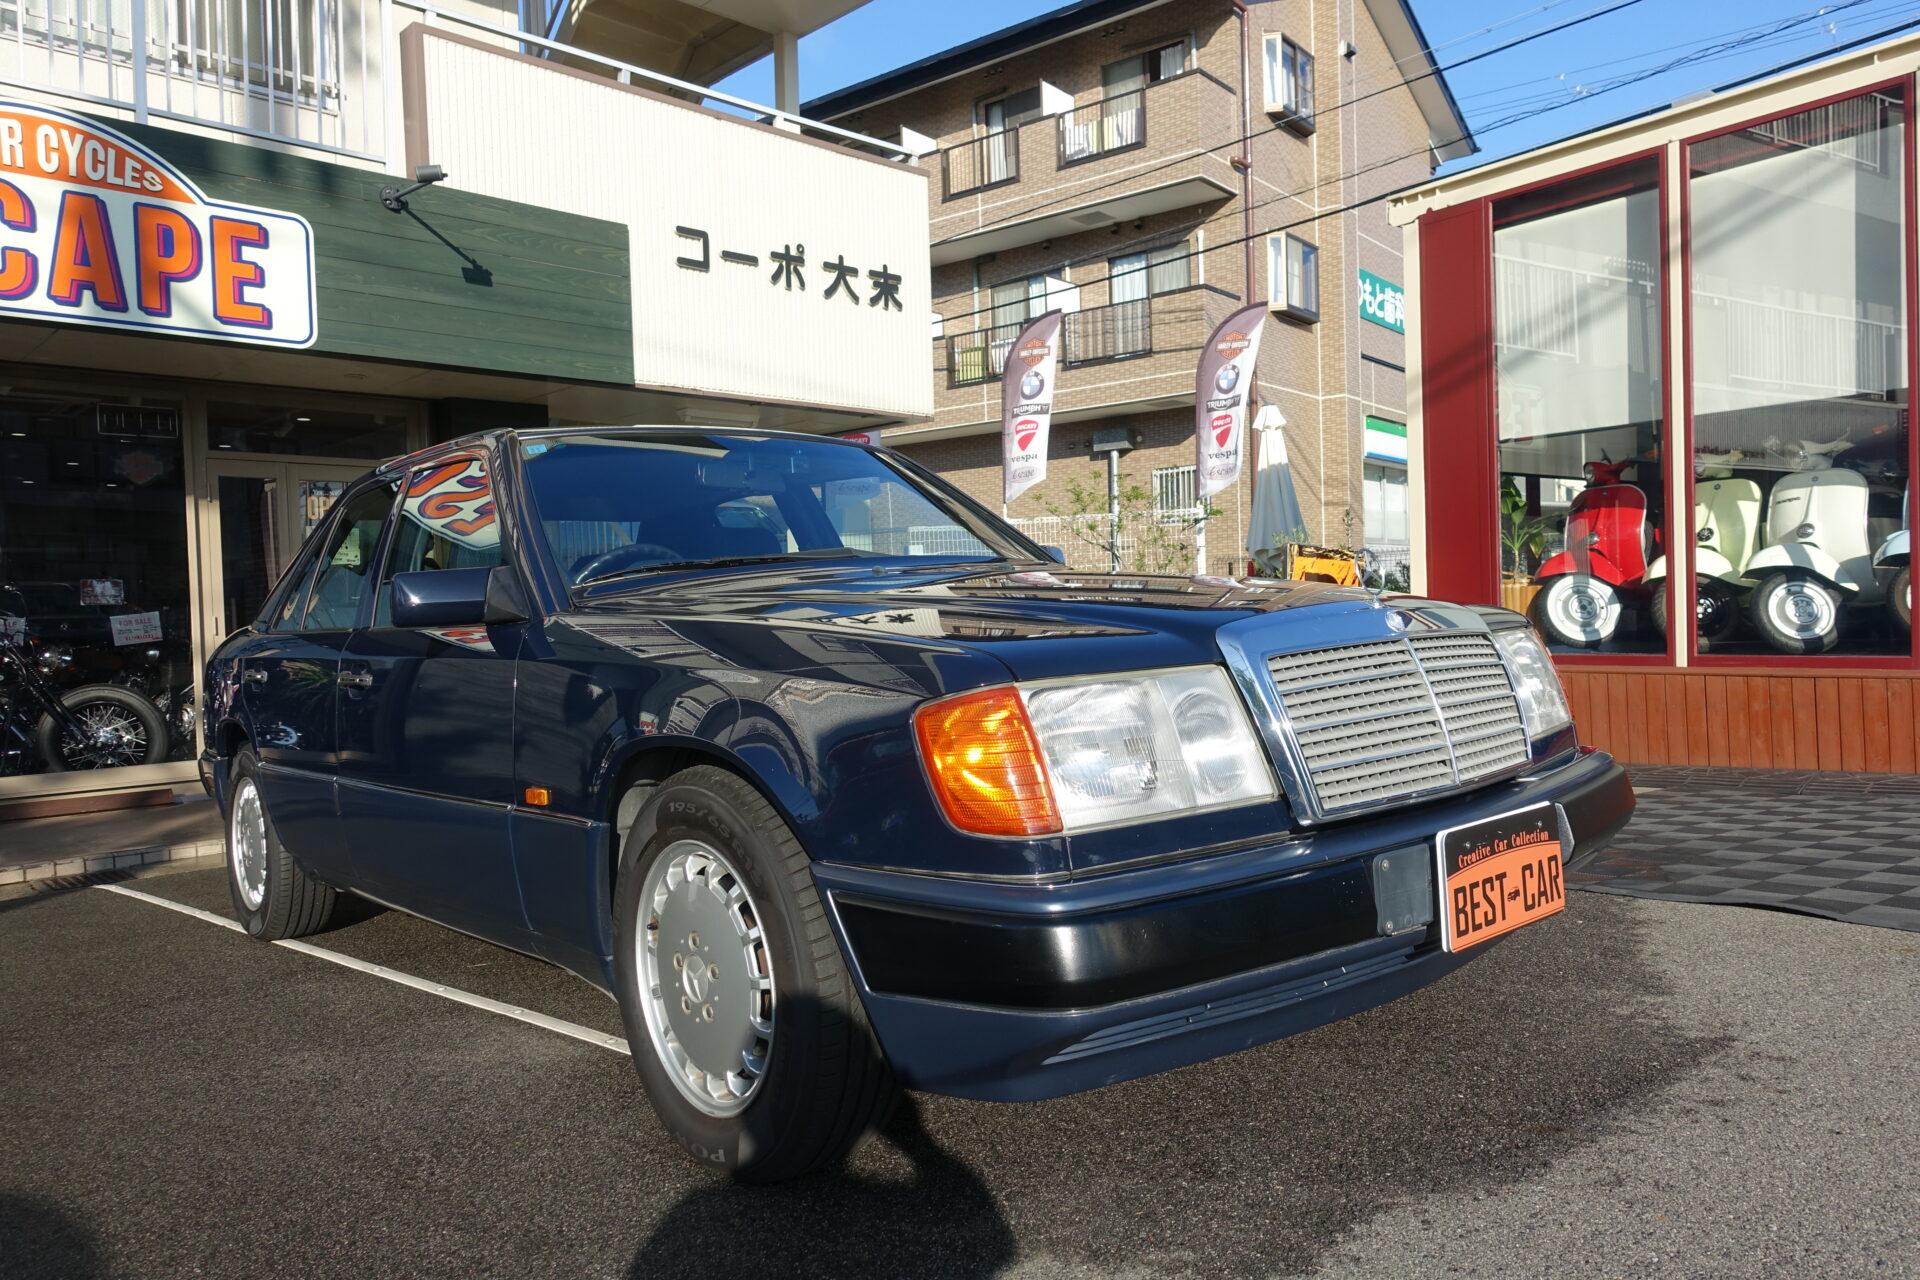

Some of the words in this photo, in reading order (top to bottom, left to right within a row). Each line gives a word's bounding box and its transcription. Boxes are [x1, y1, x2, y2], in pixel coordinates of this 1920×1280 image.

[36, 124, 163, 192] CYCLES
[675, 225, 903, 311] コーポ大末
[1013, 404, 1041, 416] TRIUMPH
[1011, 453, 1038, 463] vespa
[1208, 449, 1238, 460] vespa
[118, 619, 133, 627] FOR
[135, 617, 152, 625] SALE
[1458, 845, 1491, 869] Creative
[1494, 838, 1508, 852] Car
[1511, 829, 1549, 848] Collection
[1454, 872, 1507, 938] BEST
[1521, 854, 1562, 912] CAR
